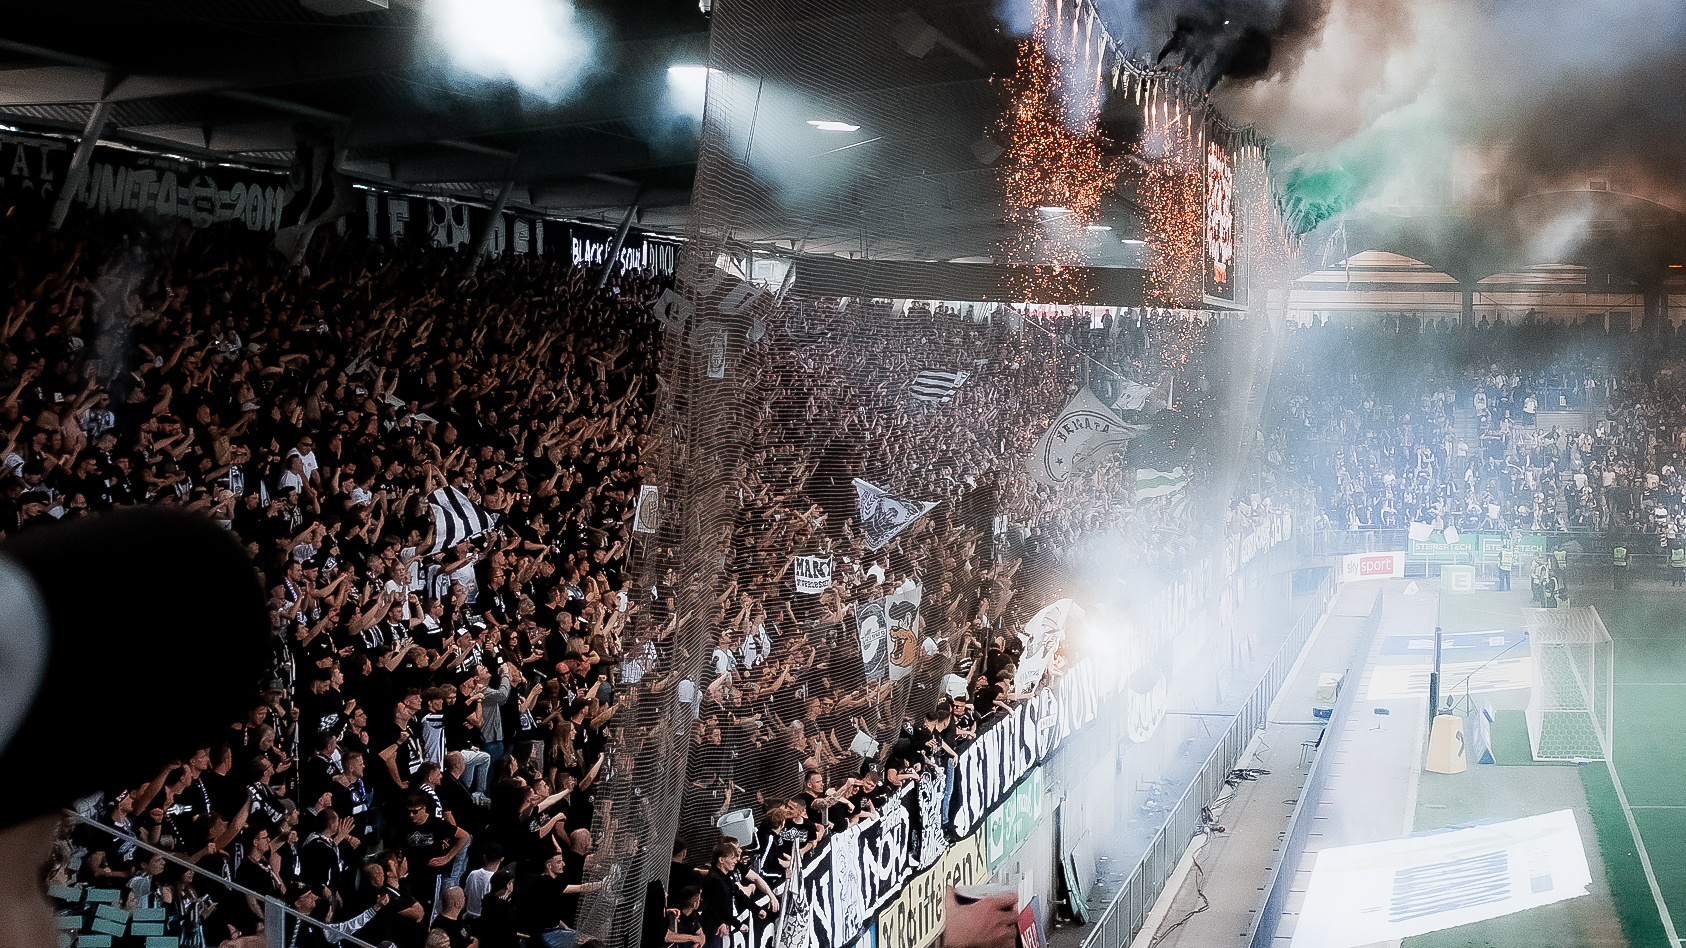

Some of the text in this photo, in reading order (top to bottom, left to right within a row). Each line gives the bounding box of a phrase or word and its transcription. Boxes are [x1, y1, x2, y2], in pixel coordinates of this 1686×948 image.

[1415, 543, 1472, 551] STEIRERTECH
[1485, 544, 1543, 552] STETECH
[1347, 558, 1392, 576] sky sport
